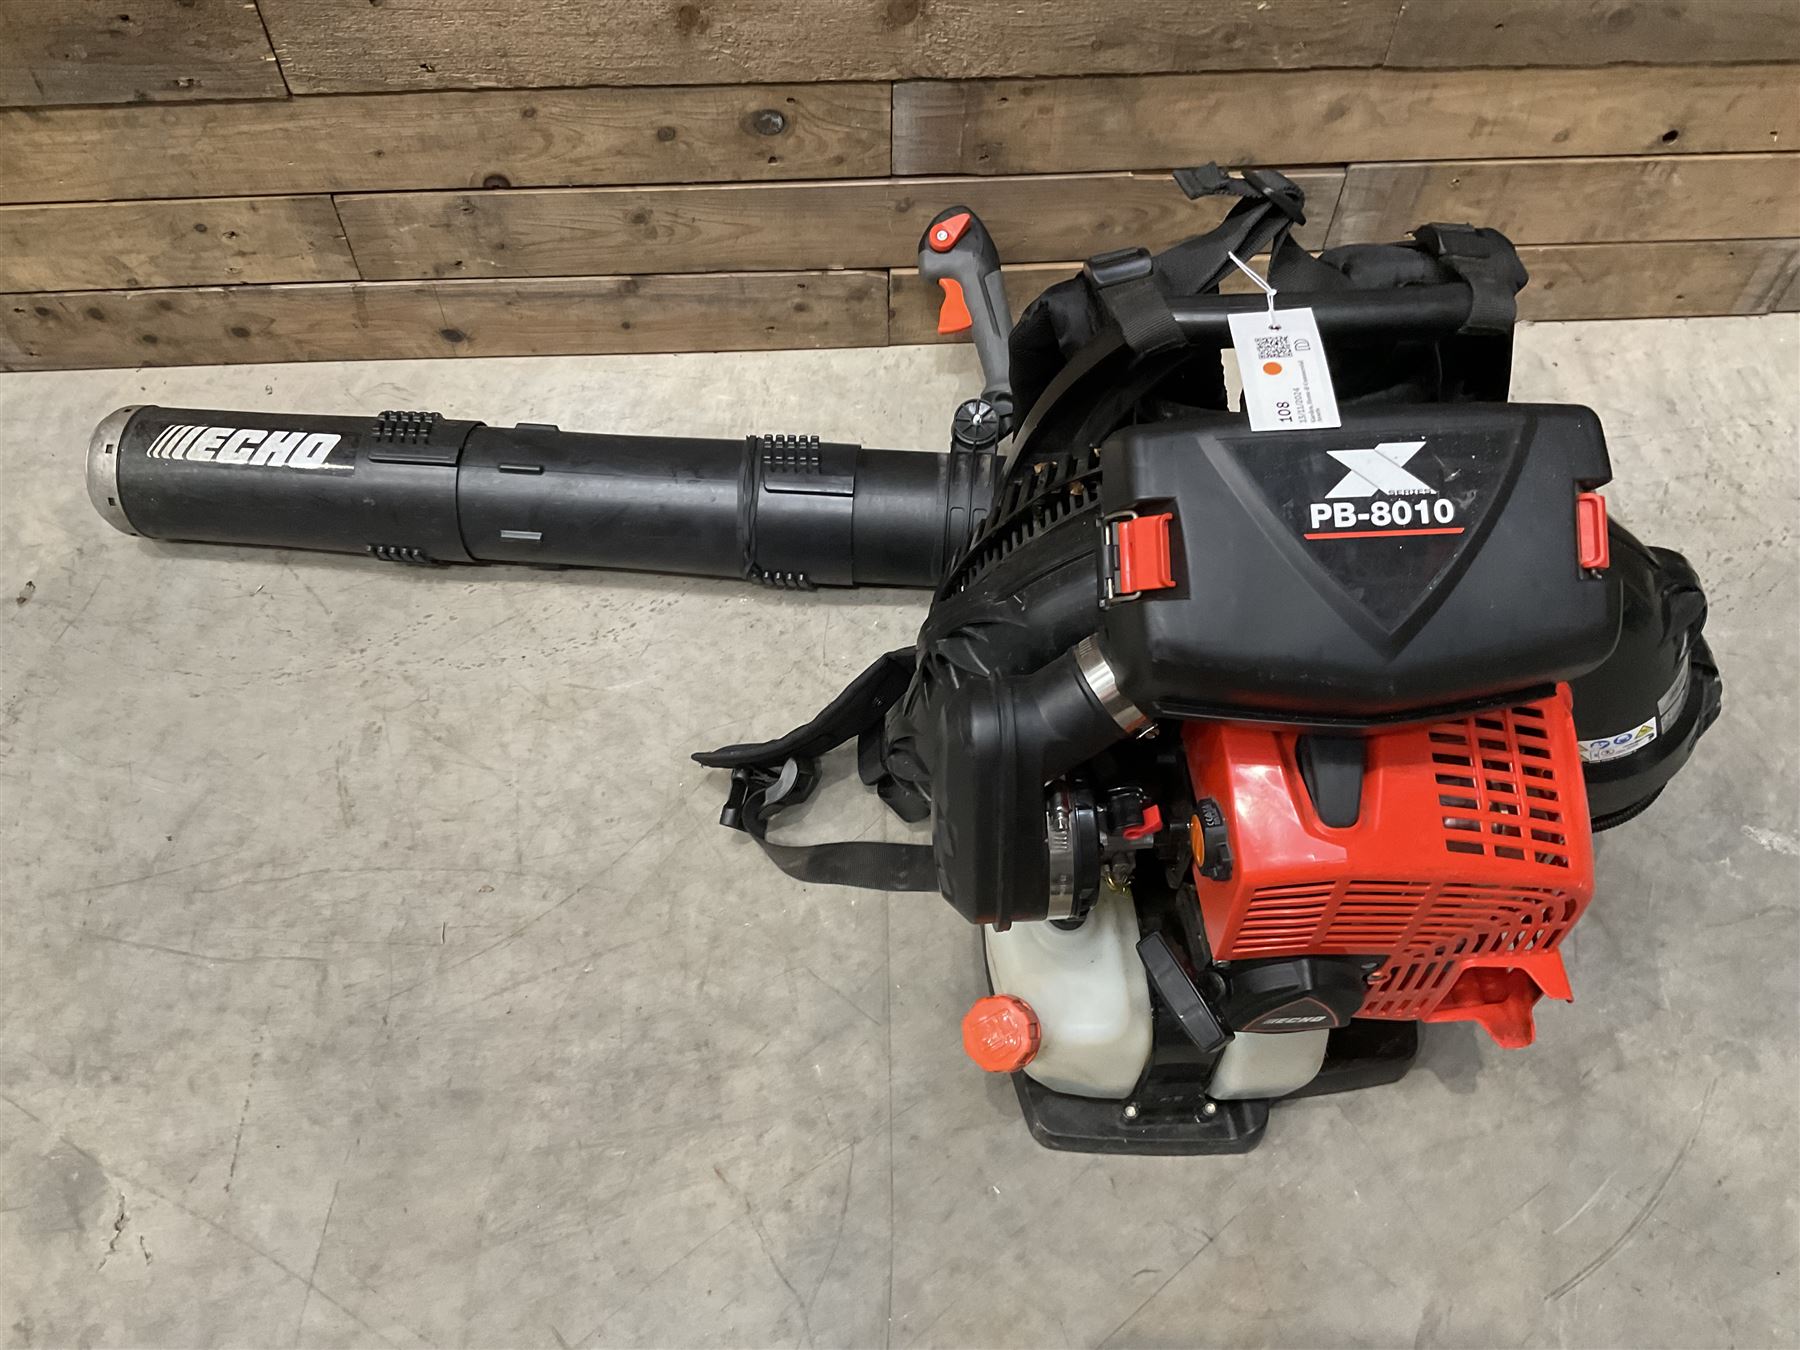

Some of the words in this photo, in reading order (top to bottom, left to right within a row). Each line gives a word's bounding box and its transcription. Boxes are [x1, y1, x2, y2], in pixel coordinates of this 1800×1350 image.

[1276, 401, 1292, 422] 108
[186, 427, 341, 469] ECHO
[1310, 498, 1455, 529] PB-8010
[1273, 1015, 1327, 1025] ECHO
